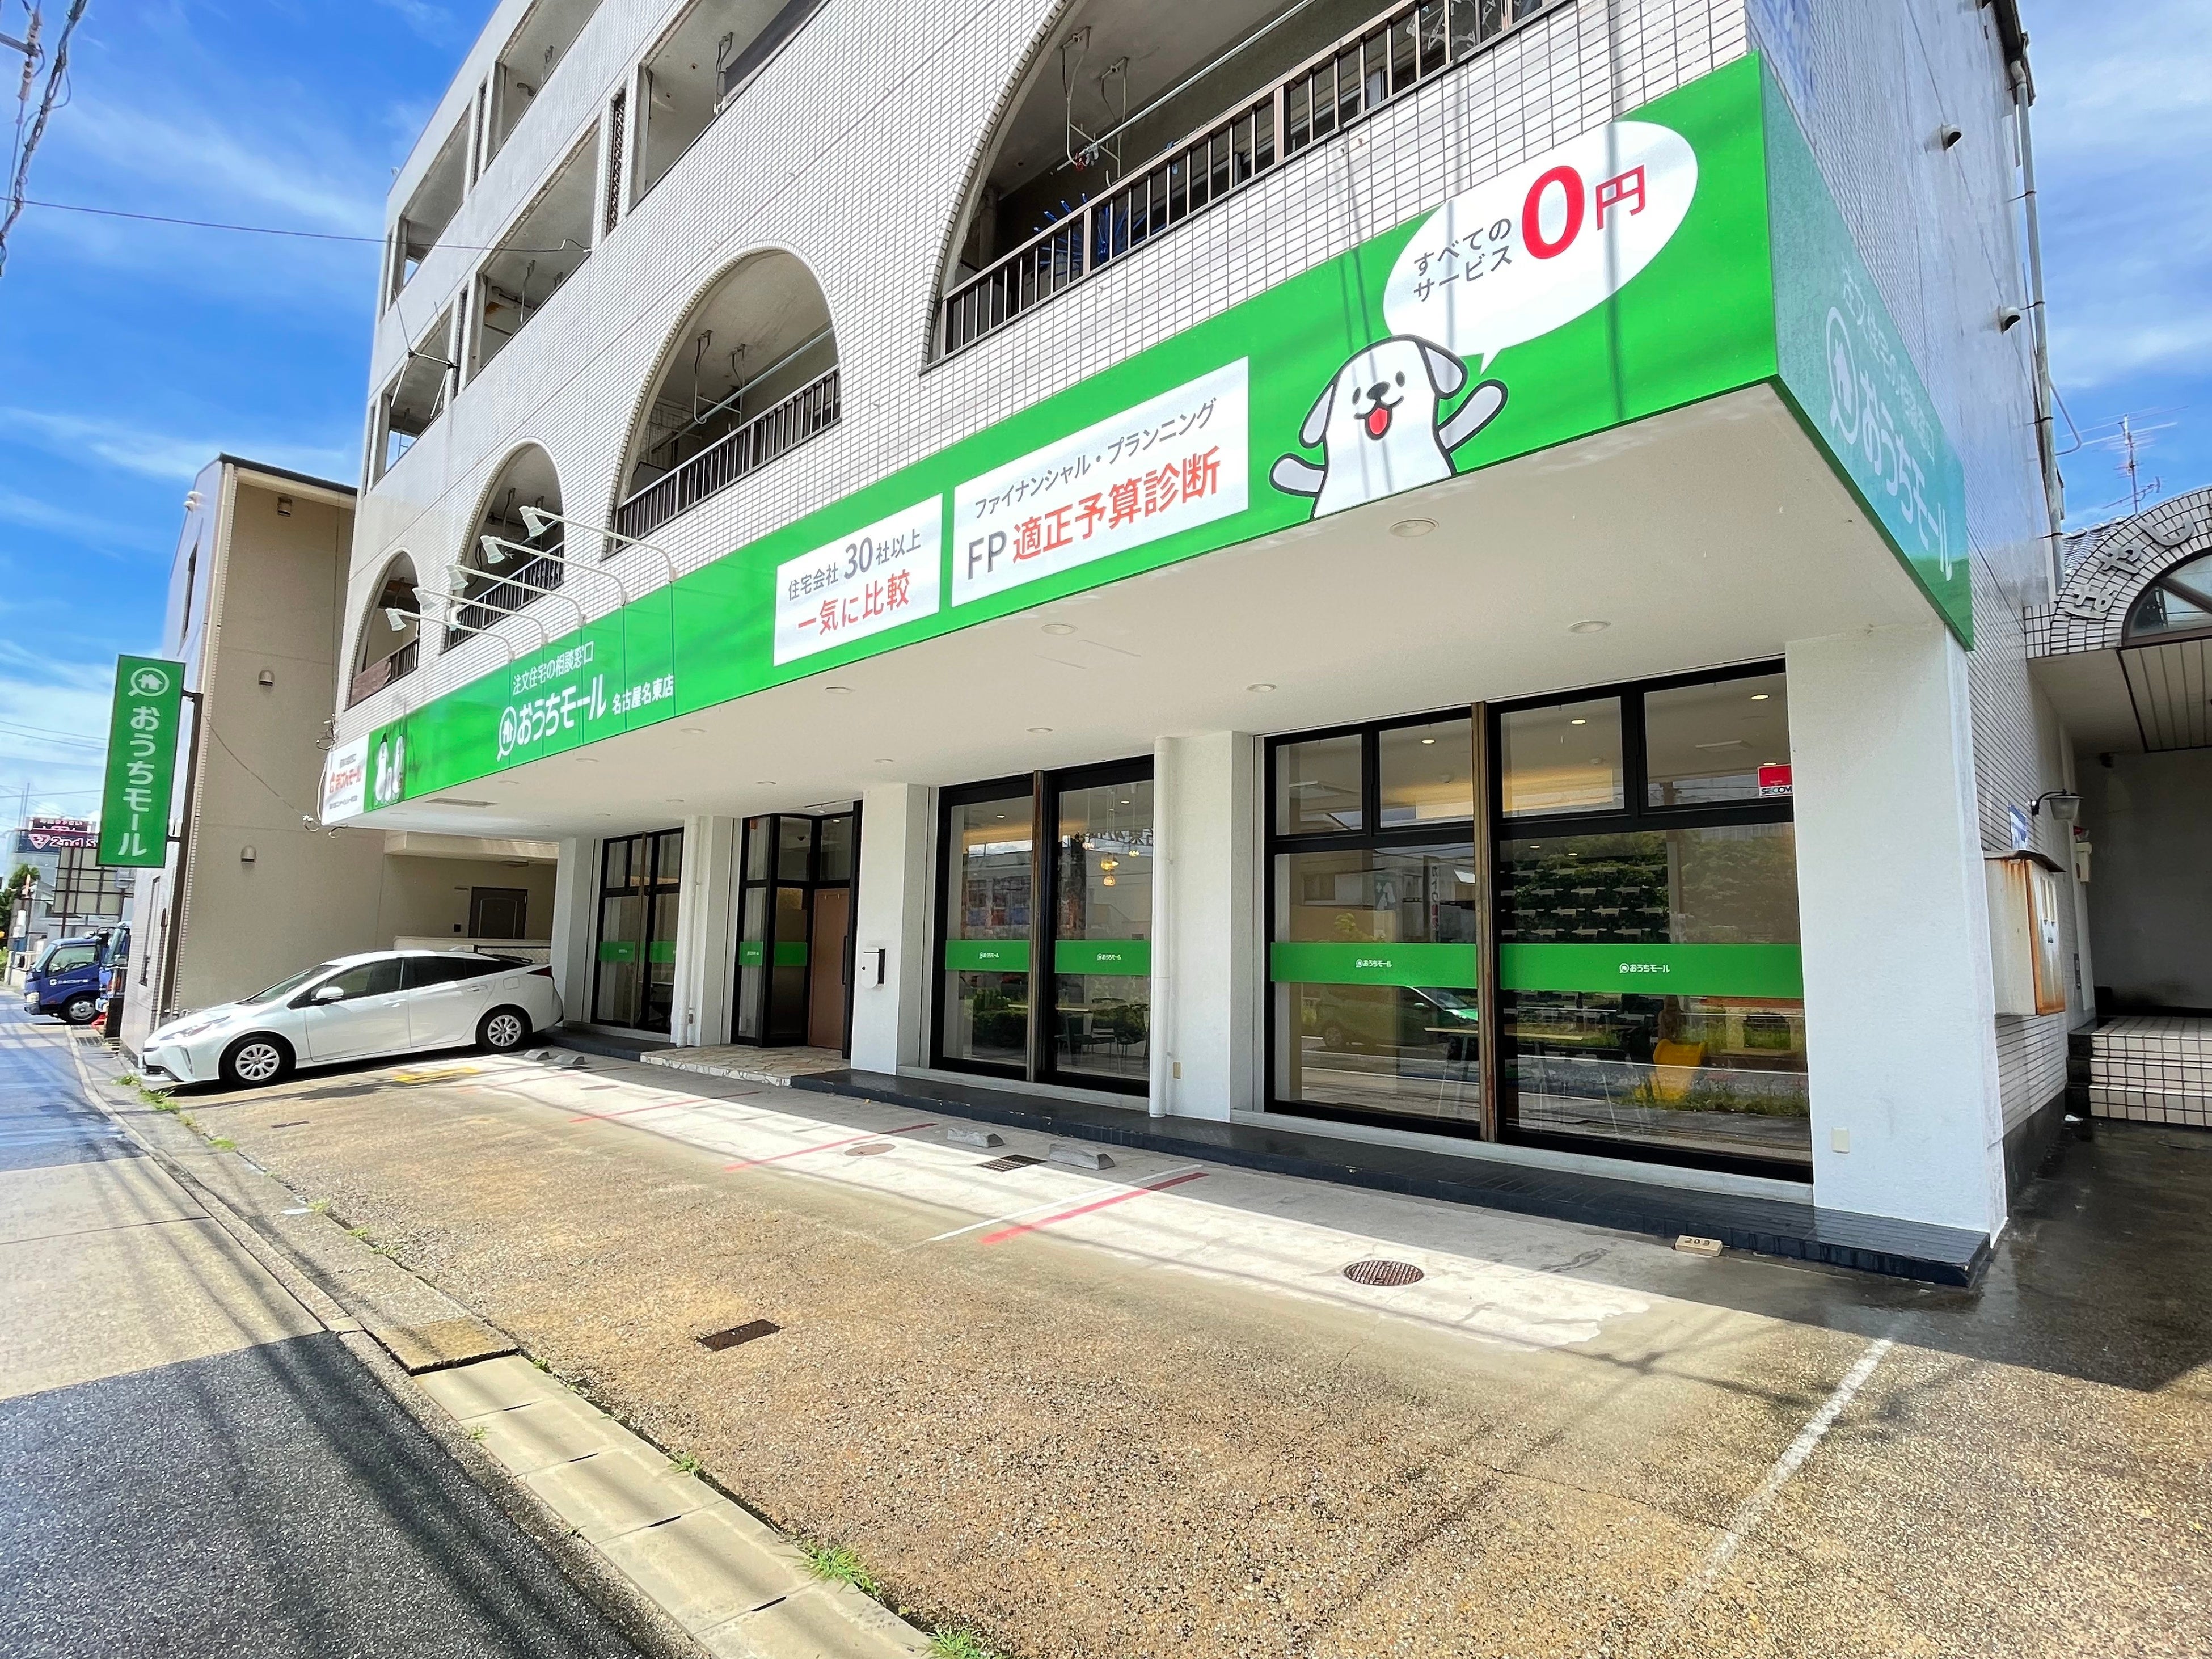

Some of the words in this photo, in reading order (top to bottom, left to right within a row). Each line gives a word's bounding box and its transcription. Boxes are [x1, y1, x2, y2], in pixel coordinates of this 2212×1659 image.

[1414, 218, 1512, 276] すべての
[1414, 245, 1512, 302] サービス
[1860, 369, 1952, 581] おうちモール
[797, 569, 910, 636] 一気に比較
[512, 641, 594, 696] 注文住宅の相談窓口
[517, 674, 607, 745] おうちモール
[611, 674, 674, 715] 名古屋名東店
[117, 706, 161, 856] おうちモール
[1630, 964, 1670, 973] おうちモール
